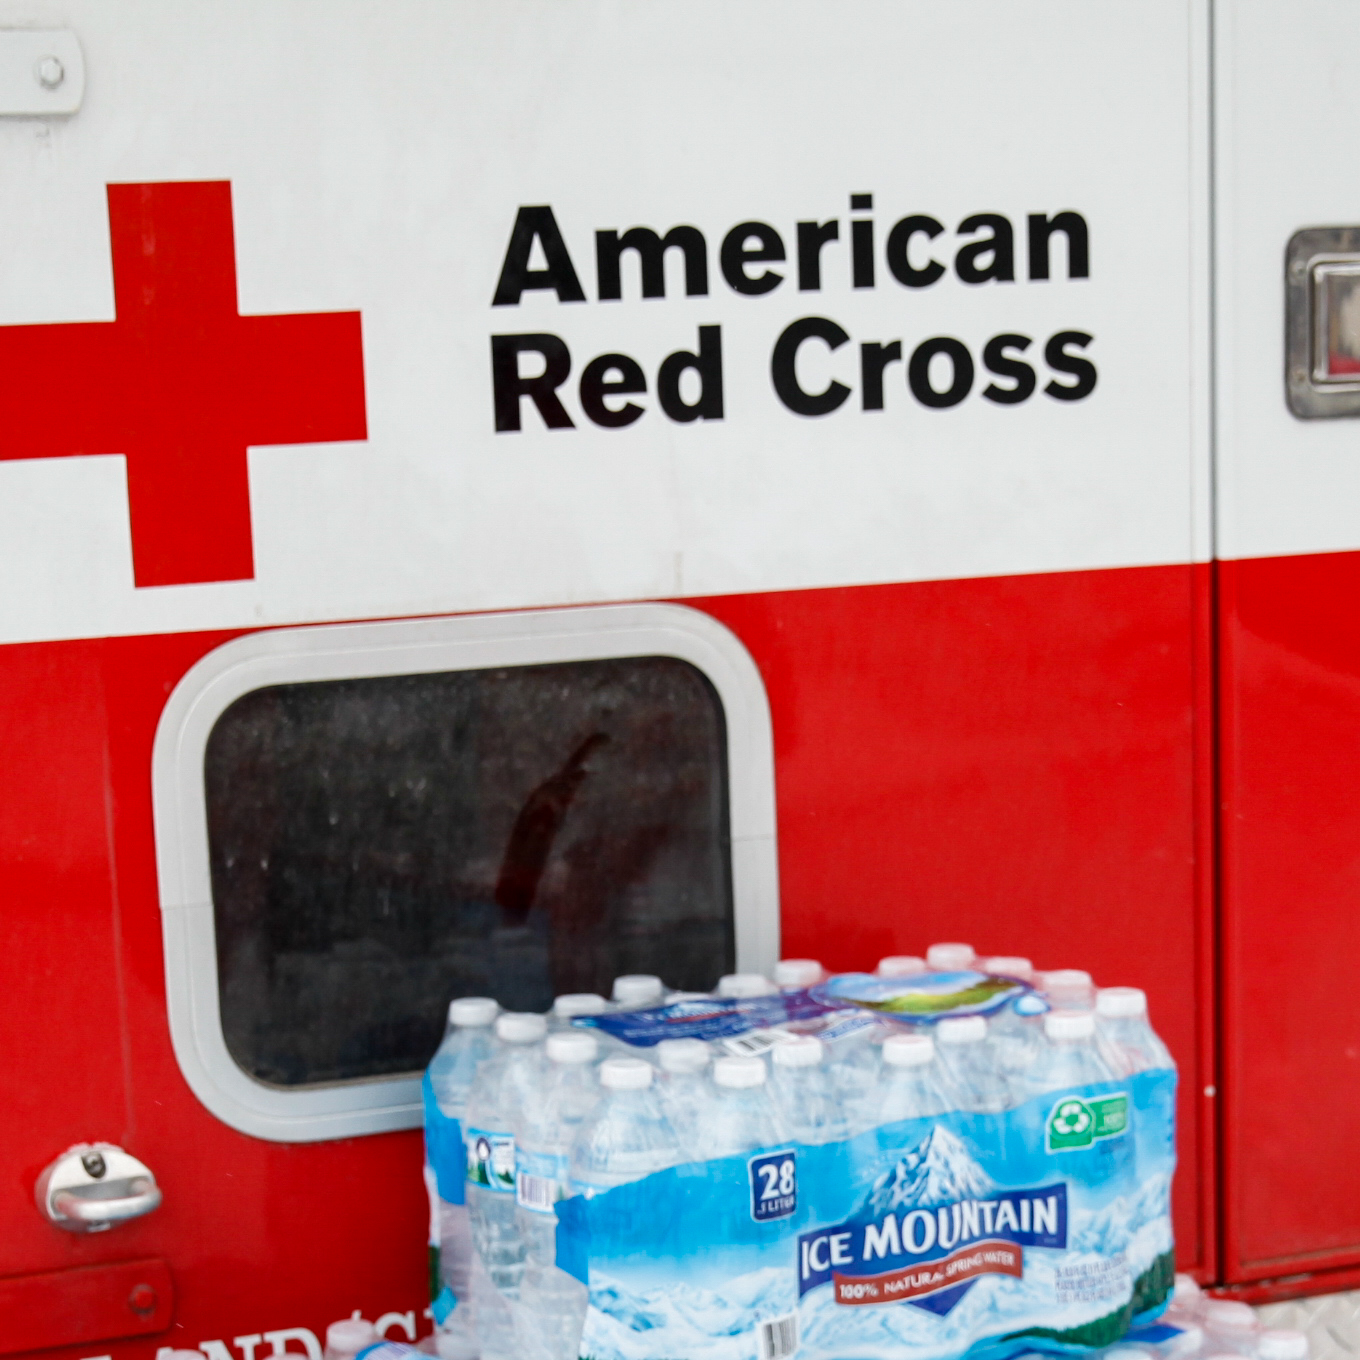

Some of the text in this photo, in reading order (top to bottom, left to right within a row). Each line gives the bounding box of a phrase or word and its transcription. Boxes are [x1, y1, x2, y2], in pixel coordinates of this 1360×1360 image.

[491, 192, 1090, 307] American
[490, 316, 1099, 434] Red Cross
[757, 1160, 795, 1201] 28
[800, 1195, 1059, 1280] ICE MOUNTAIN
[839, 1282, 880, 1300] 100%
[945, 1252, 983, 1277] SPRING
[984, 1250, 1017, 1267] WATER
